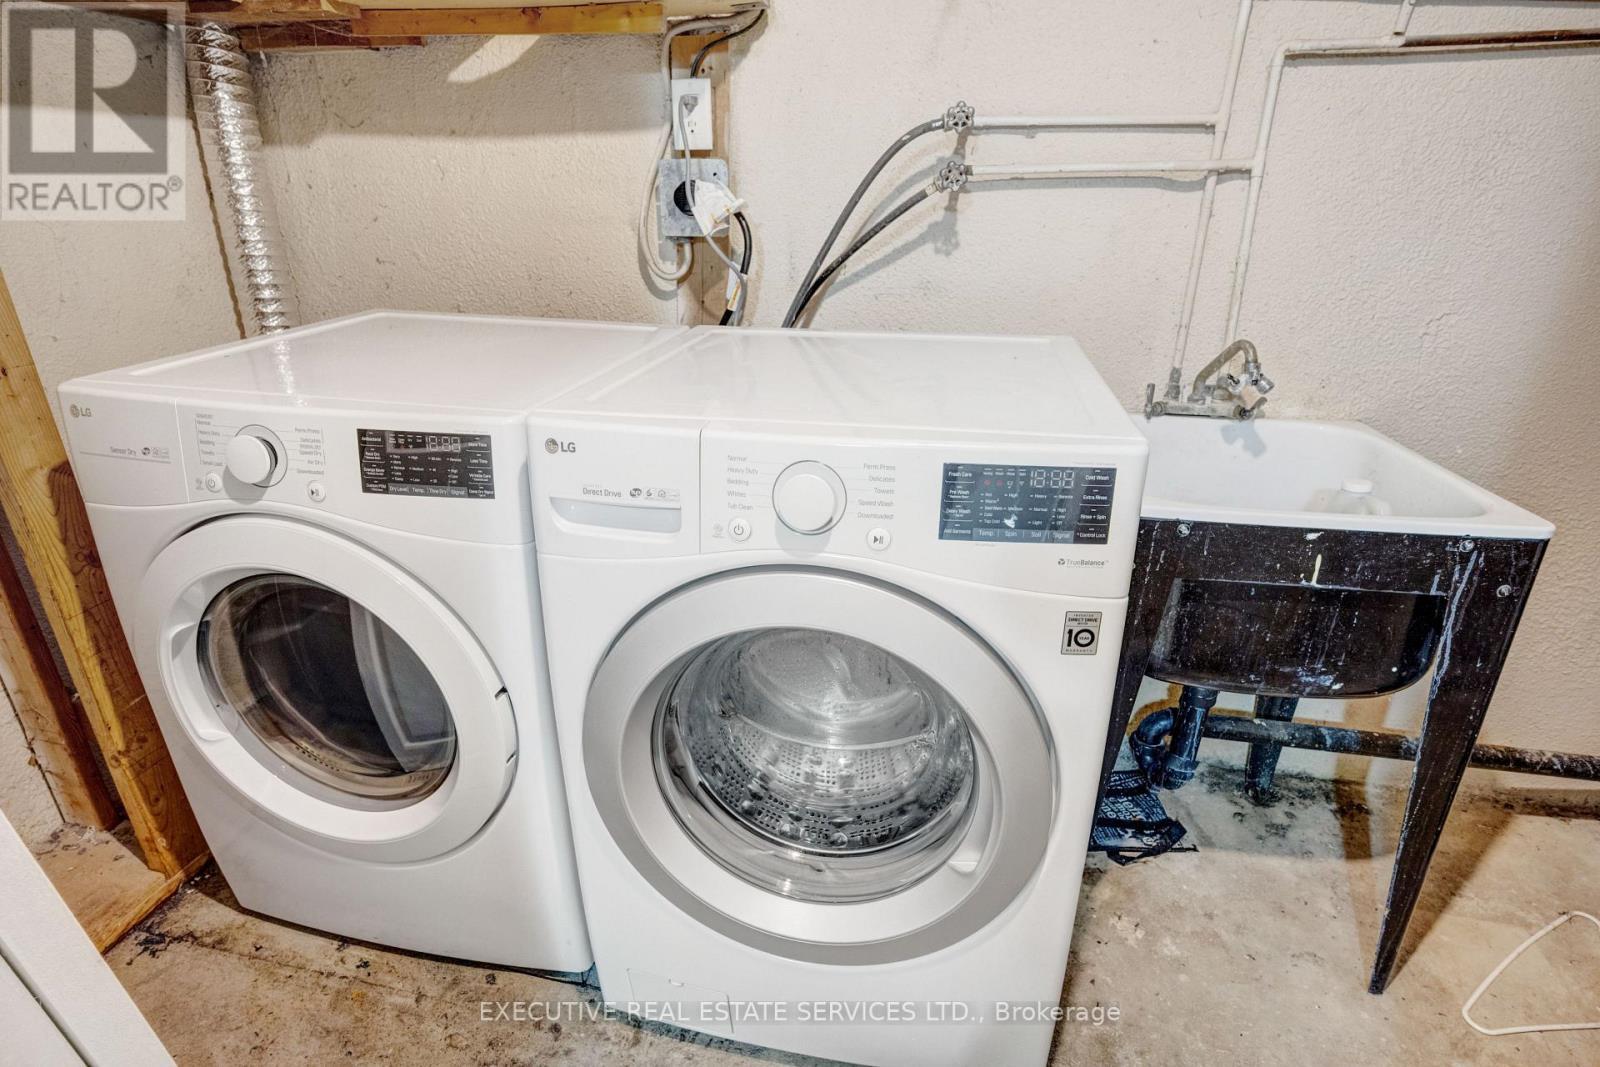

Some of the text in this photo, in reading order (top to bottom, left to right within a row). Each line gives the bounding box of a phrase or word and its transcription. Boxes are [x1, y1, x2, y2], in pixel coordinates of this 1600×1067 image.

[80, 407, 92, 417] LG
[560, 441, 576, 453] LG
[582, 487, 603, 496] Direct
[604, 489, 622, 497] Drive
[1067, 628, 1095, 648] 10
